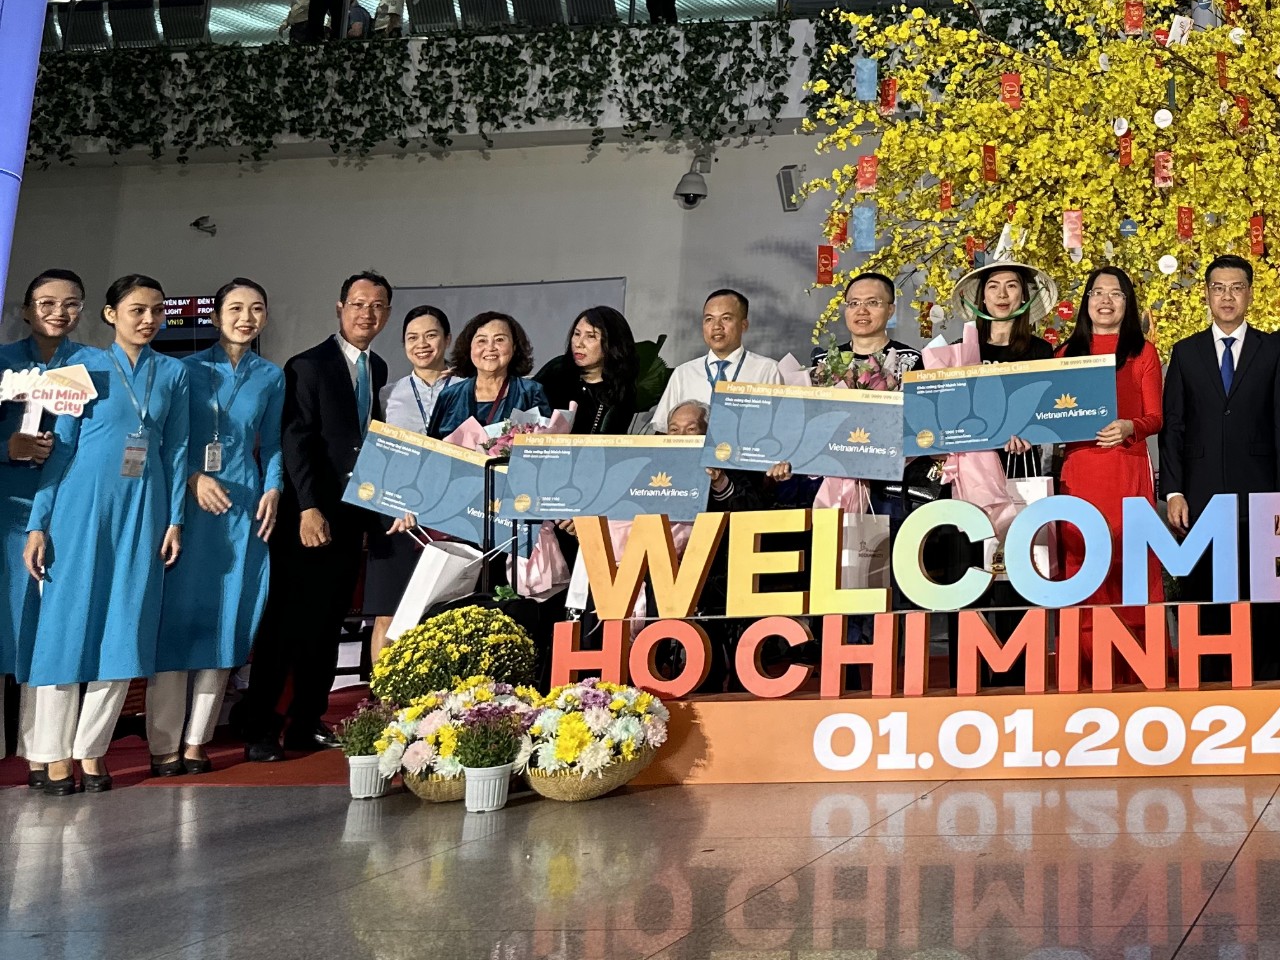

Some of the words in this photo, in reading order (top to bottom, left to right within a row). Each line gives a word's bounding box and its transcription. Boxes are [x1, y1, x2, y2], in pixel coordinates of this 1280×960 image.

[31, 389, 53, 400] Chi
[55, 389, 88, 401] Minh
[54, 401, 82, 414] City
[1036, 410, 1067, 421] Vietnam
[1067, 408, 1097, 419] Airlines
[828, 442, 859, 453] Vietnam
[859, 445, 887, 455] Airlines
[629, 488, 661, 497] Vietnam
[661, 488, 689, 497] Airlines
[549, 619, 712, 700] HO
[735, 611, 930, 698] CHI
[957, 602, 1253, 695] MINH
